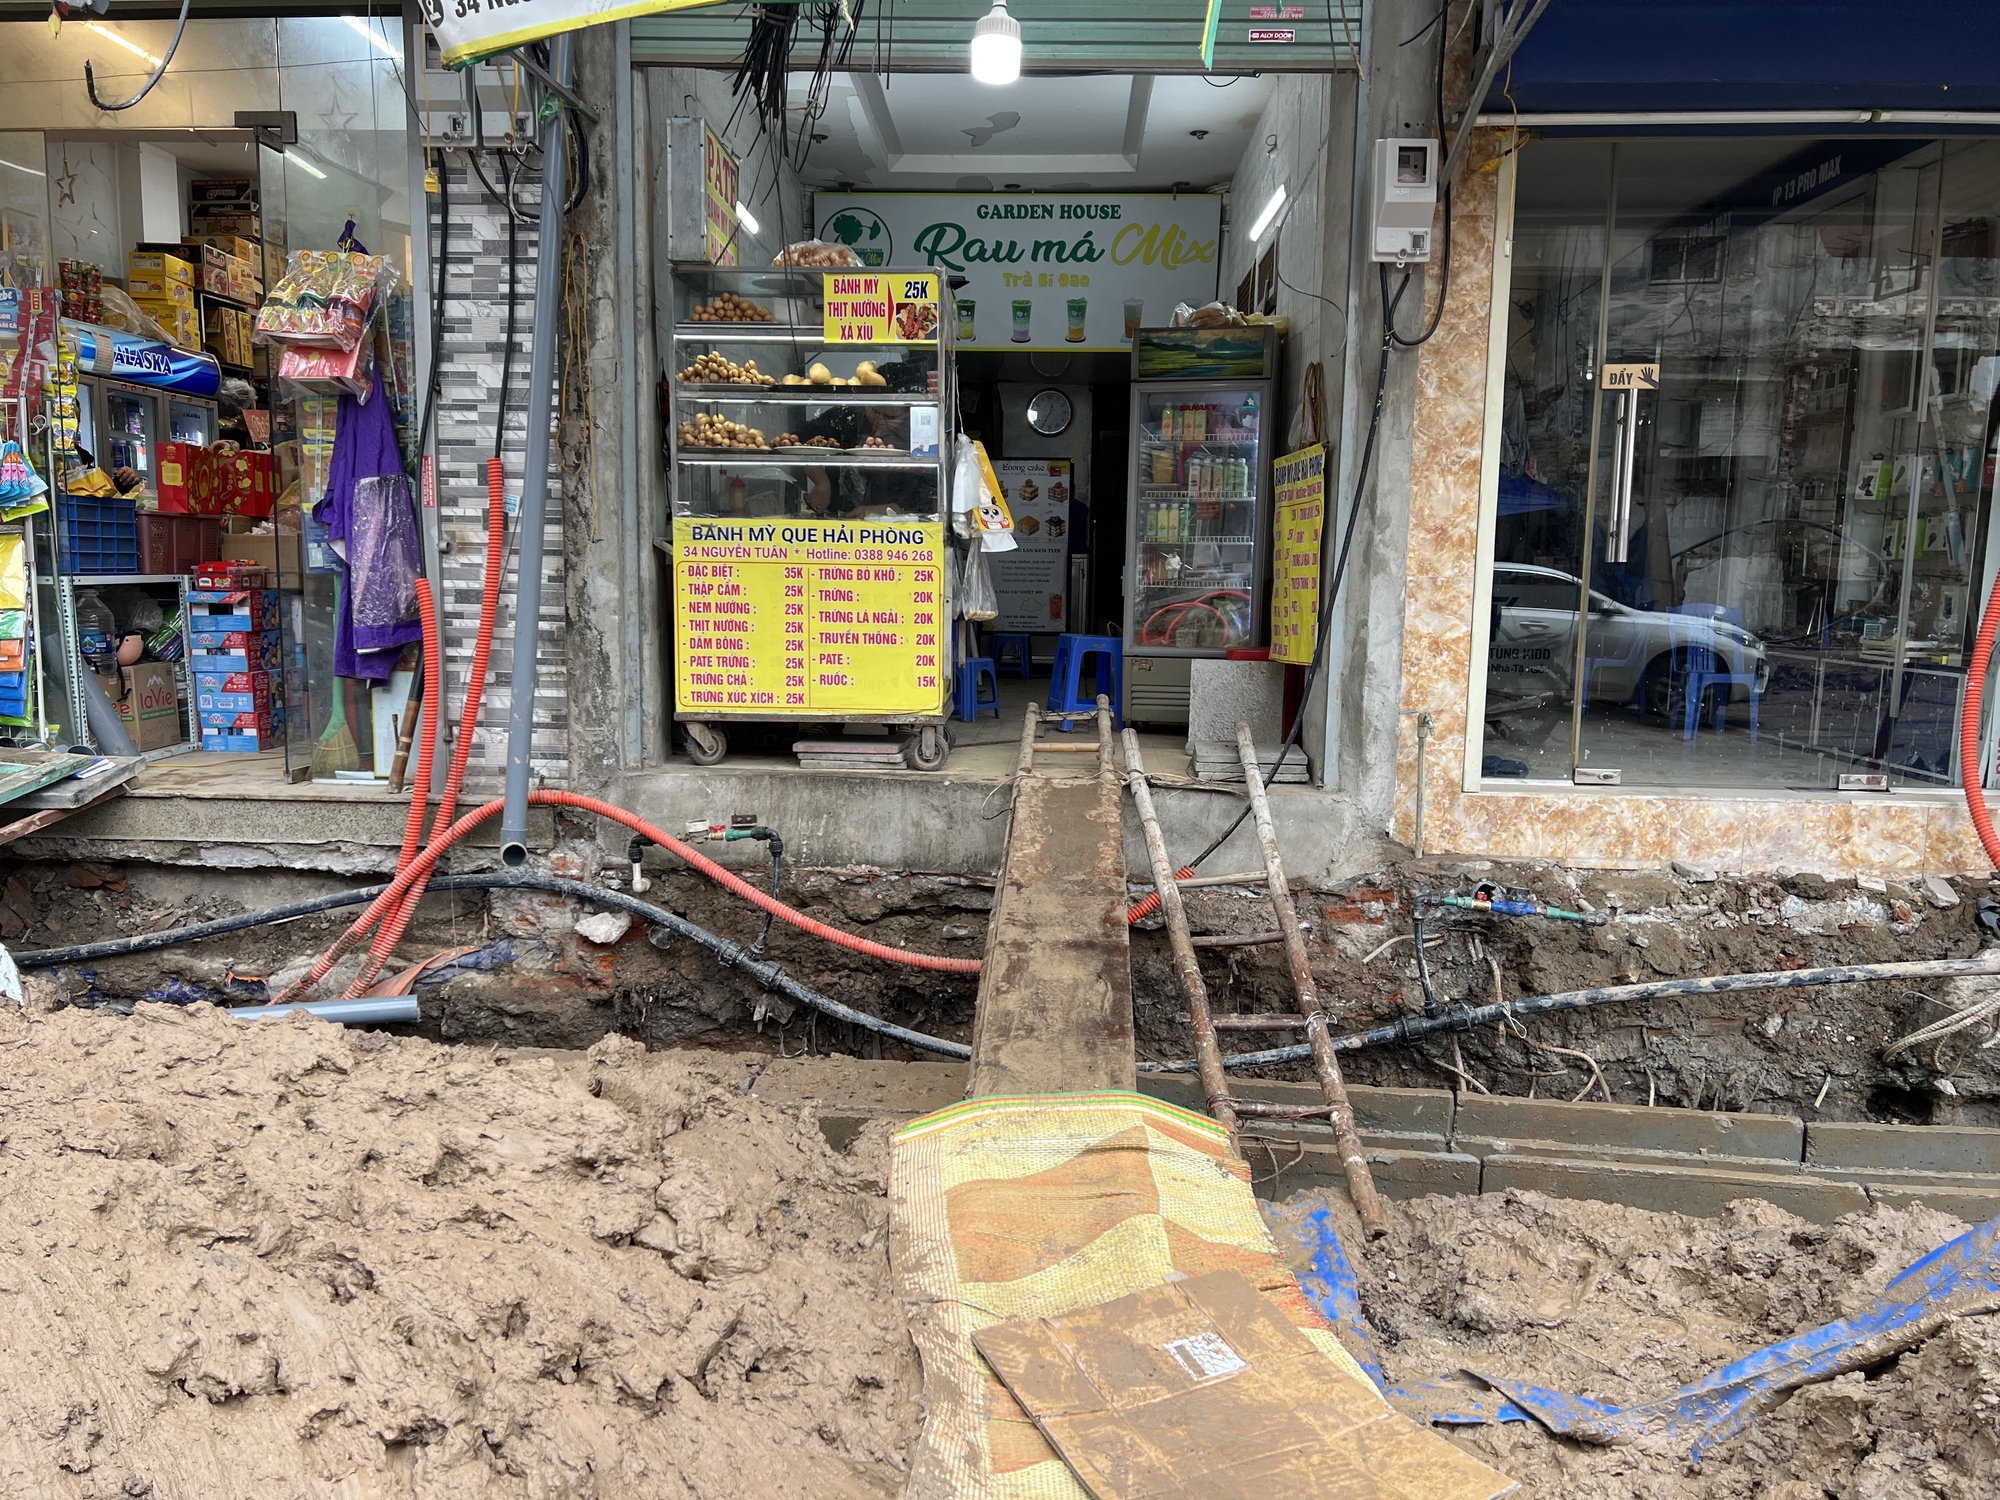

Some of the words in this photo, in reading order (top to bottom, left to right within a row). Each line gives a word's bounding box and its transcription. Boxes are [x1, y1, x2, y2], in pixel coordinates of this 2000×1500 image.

[706, 134, 737, 213] PATE
[1772, 186, 1782, 207] IP
[1784, 179, 1796, 201] 13
[1796, 167, 1817, 195] PRO
[1818, 154, 1842, 184] MAX
[977, 203, 1054, 219] GARDEN
[1059, 204, 1121, 220] HOUSE
[913, 222, 1026, 272] Rau
[1030, 230, 1106, 264] má
[1110, 222, 1215, 271] Mix
[834, 275, 861, 294] BÁNH
[864, 275, 880, 294] MỲ
[904, 281, 929, 299] 25K
[1002, 271, 1033, 288] Trà
[1038, 273, 1054, 288] Bí
[827, 302, 848, 321] THỊT
[851, 299, 886, 318] NƯỚNG
[841, 321, 853, 341] XÁ
[856, 321, 873, 341] XÍU
[114, 343, 174, 376] ALASKA
[1609, 368, 1634, 385] ĐẨY
[692, 523, 743, 541] BÁNH
[749, 524, 776, 542] MỲ
[781, 528, 818, 544] QUE
[823, 524, 854, 544] HẢI
[860, 526, 924, 545] PHÒNG
[683, 546, 698, 557] 34
[806, 548, 851, 560] Hotline:
[854, 549, 883, 561] 0388
[886, 550, 908, 561] 946
[912, 550, 933, 562] 268
[688, 563, 708, 580] ĐẶC
[711, 563, 733, 581] BIỆT
[784, 567, 804, 579] 35K
[818, 566, 853, 581] TRỨNG
[874, 567, 895, 581] KHÔ
[914, 570, 934, 582] 25K
[688, 581, 714, 598] THẬP
[784, 585, 804, 597] 25K
[818, 587, 853, 602] TRỨNG
[913, 592, 933, 603] 20K
[688, 601, 712, 614] NEM
[715, 600, 750, 614] NƯỚNG
[784, 603, 804, 615] 25K
[818, 609, 853, 624] TRỨNG
[856, 609, 870, 624] LÁ
[913, 613, 933, 624] 20K
[689, 620, 711, 634] THỊT
[713, 618, 748, 632] NƯỚNG
[785, 622, 804, 633] 25K
[715, 636, 743, 650] BÔNG
[785, 640, 804, 651] 25K
[862, 629, 897, 645] THỐNG
[915, 634, 936, 646] 20K
[819, 654, 843, 665] PATE
[915, 655, 936, 666] 20K
[1490, 645, 1519, 659] TÙNG
[1523, 648, 1551, 660] KIDD
[690, 656, 713, 667] PATE
[716, 654, 749, 668] TRỨNG
[785, 658, 804, 669] 25K
[690, 671, 723, 686] TRỨNG
[727, 670, 747, 686] CHẢ
[785, 675, 805, 687] 25K
[819, 670, 848, 686] RUỐC
[917, 676, 936, 687] 15K
[139, 686, 173, 711] laVie
[690, 689, 723, 703] TRỨNG
[727, 689, 747, 703] XÚC
[750, 690, 774, 703] XÍCH
[786, 693, 805, 704] 25K
